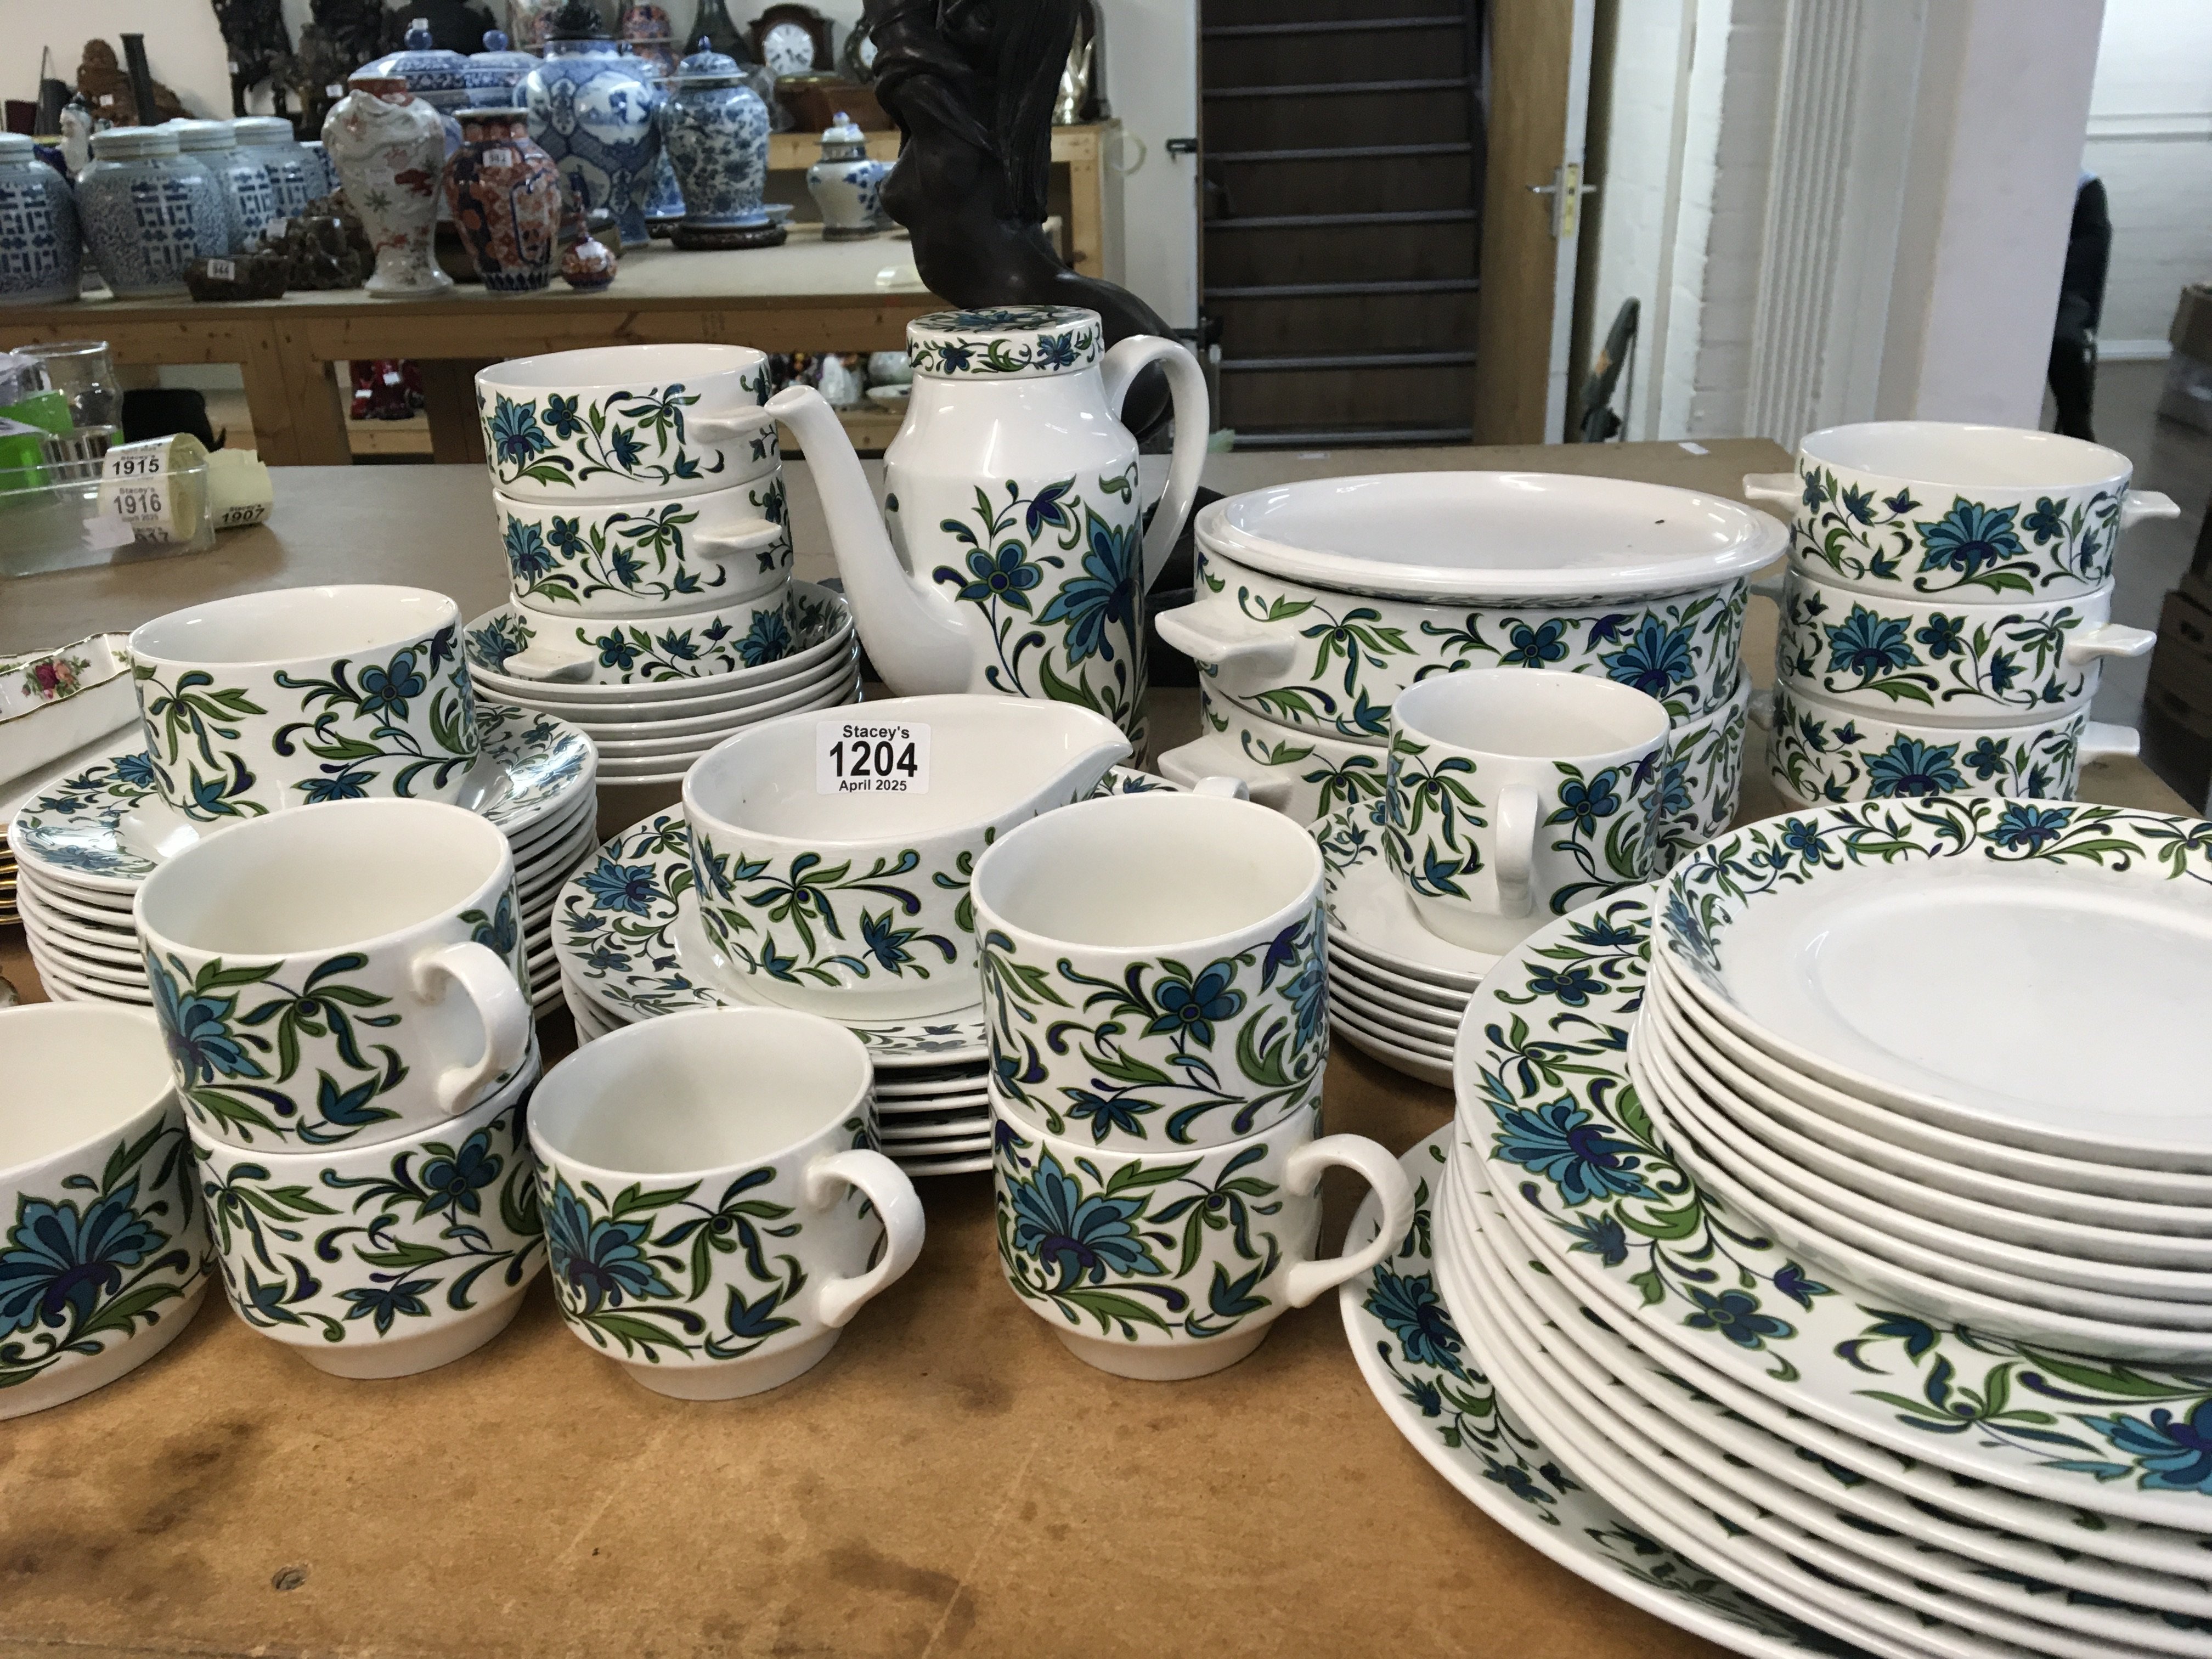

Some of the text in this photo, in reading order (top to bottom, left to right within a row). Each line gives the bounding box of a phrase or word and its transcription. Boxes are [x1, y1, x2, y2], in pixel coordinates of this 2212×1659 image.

[112, 459, 159, 475] 1915
[114, 493, 161, 514] 1916
[222, 508, 265, 522] 1907
[843, 725, 910, 741] Stacey's
[830, 741, 918, 777] 1204
[839, 779, 907, 793] April 2025
